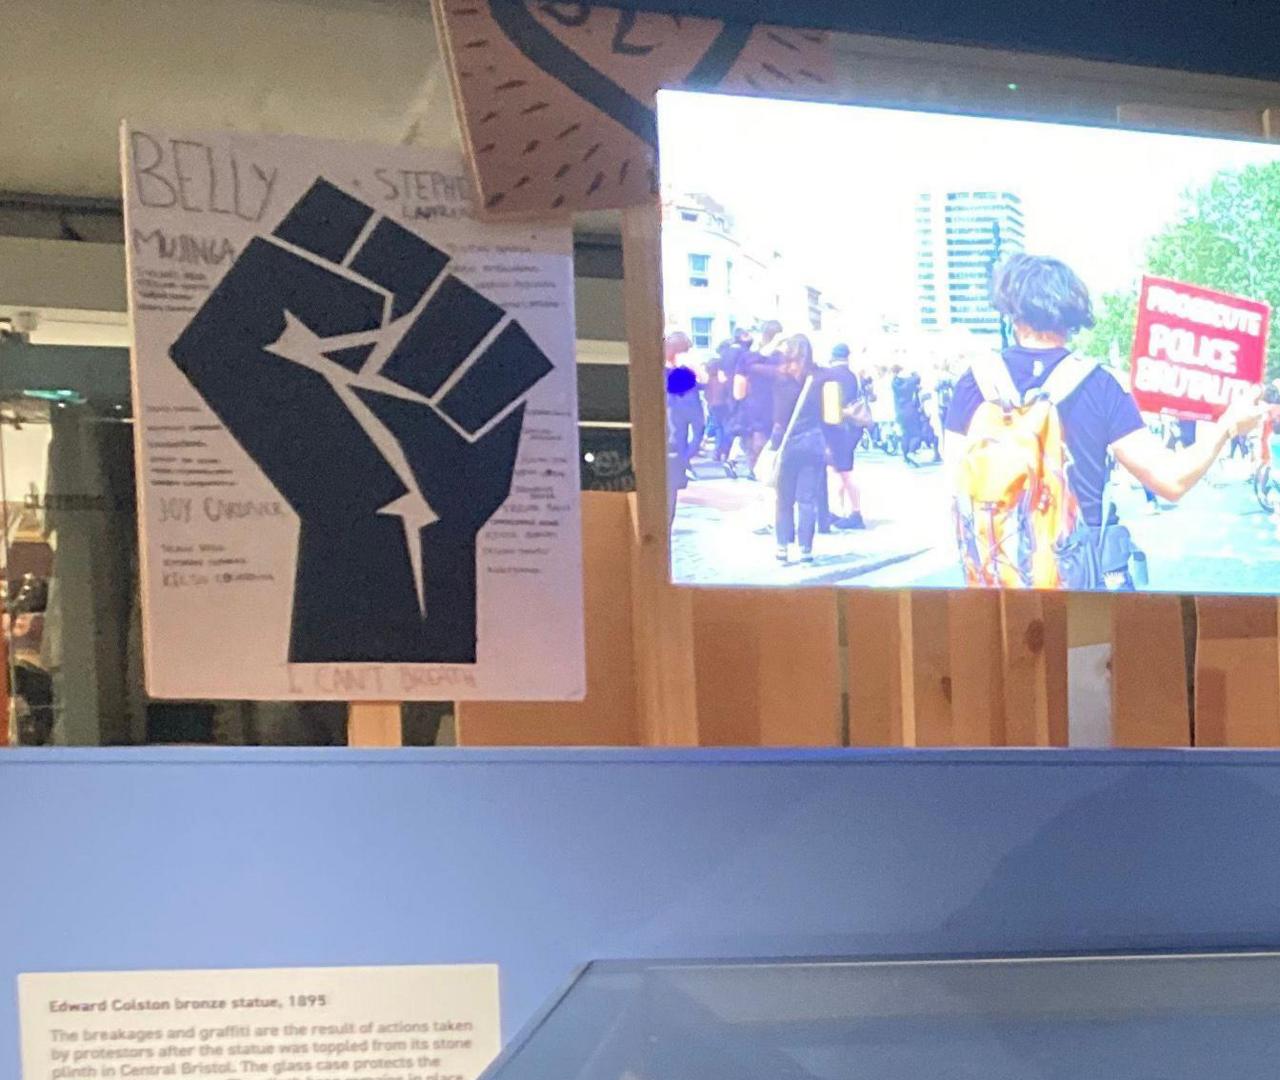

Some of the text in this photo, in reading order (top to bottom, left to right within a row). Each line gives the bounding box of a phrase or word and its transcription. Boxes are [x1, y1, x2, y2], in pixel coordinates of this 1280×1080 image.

[131, 131, 278, 222] BELLY
[1148, 323, 1240, 374] POLICE
[49, 995, 327, 1013] Edward Colston bronze statue, 1895
[51, 1020, 473, 1043] The breakages and graffiti are the result of actions taken
[51, 1039, 472, 1062] by protestors after the statue was toppled from its stone
[51, 1055, 441, 1080] plinth in Central Bristol. The glass case protects the
